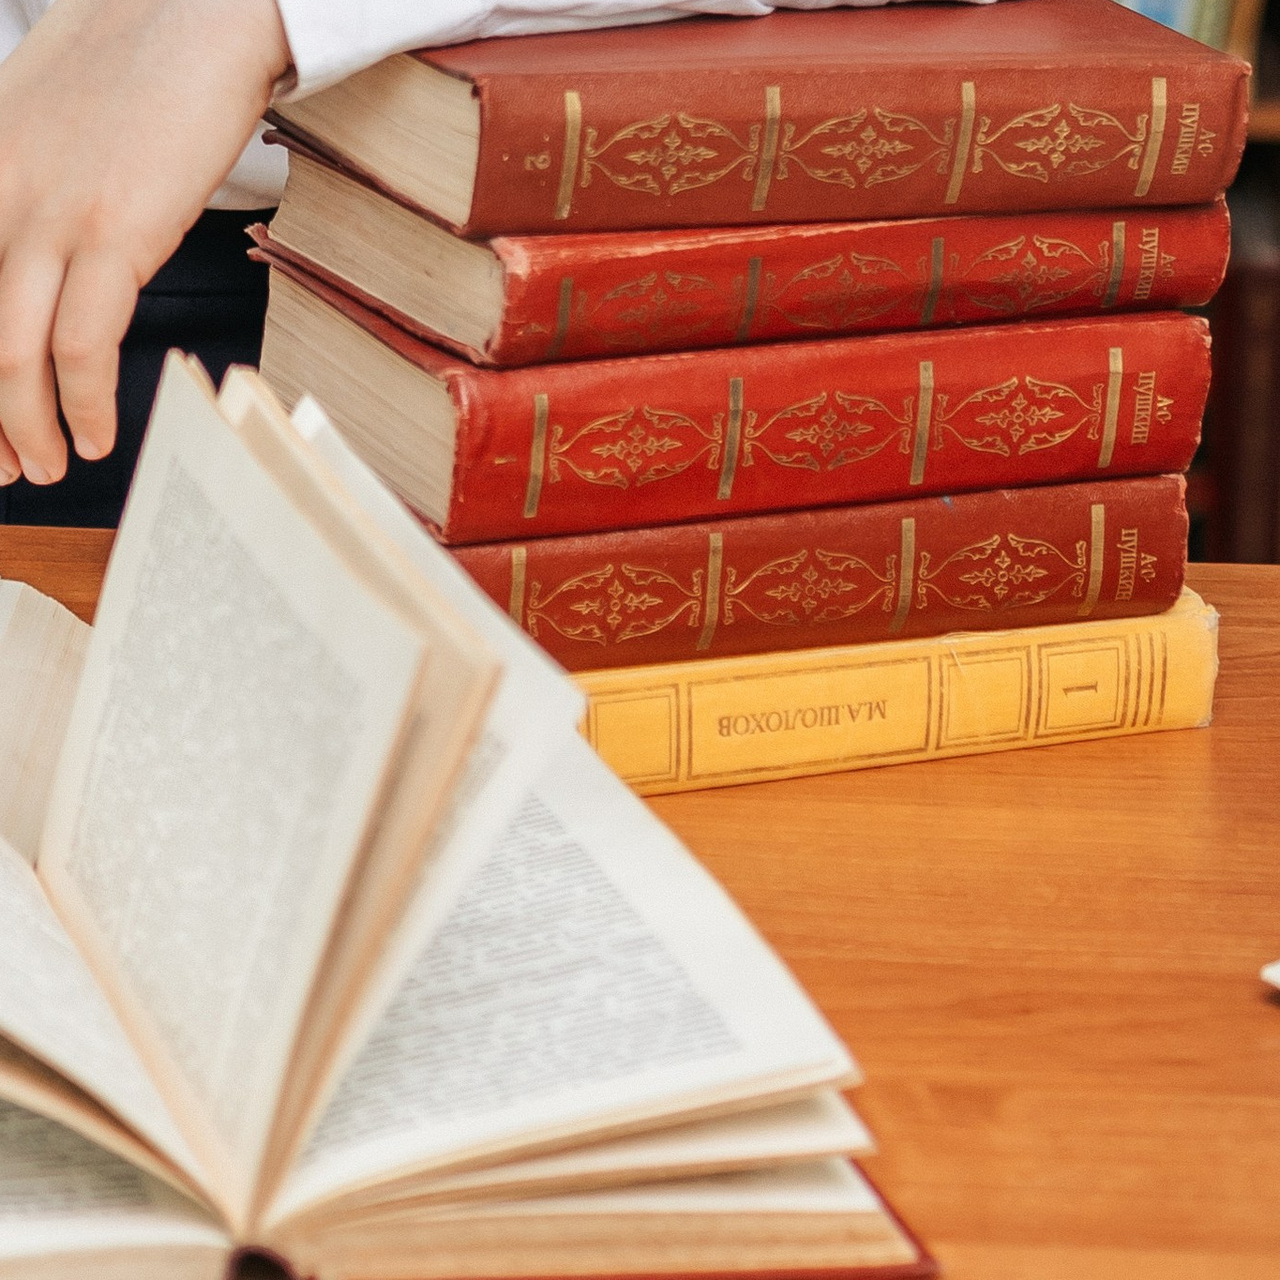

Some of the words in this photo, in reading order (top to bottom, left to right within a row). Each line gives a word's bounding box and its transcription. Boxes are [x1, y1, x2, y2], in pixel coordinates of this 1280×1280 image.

[1171, 103, 1201, 175] ПУШКИН
[1133, 227, 1160, 300] ПУШКИН
[1131, 371, 1156, 444] ПУШКИН
[1115, 528, 1139, 601] ПУШКИН
